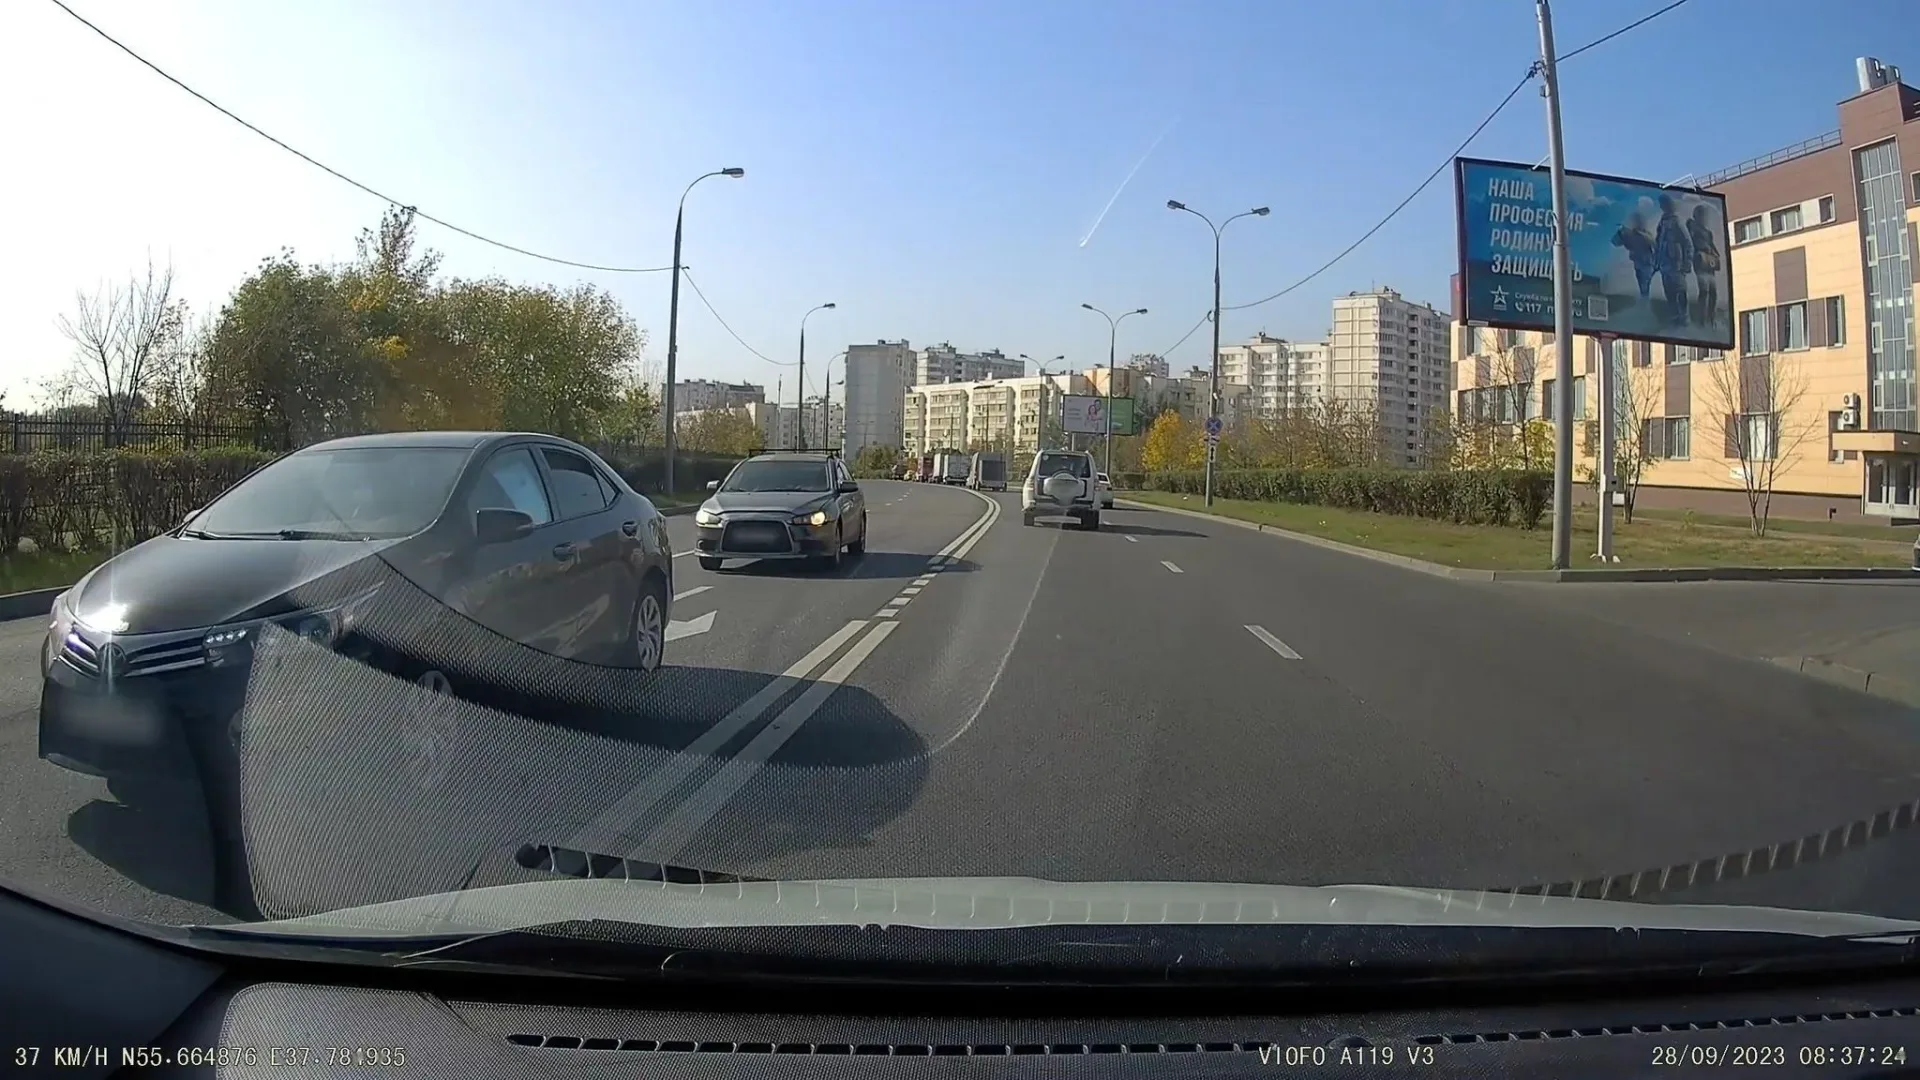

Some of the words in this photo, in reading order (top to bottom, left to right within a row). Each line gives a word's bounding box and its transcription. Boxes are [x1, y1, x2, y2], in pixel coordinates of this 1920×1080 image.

[1488, 177, 1534, 201] НАША
[1489, 202, 1584, 231] ПРОФЕСИЯ
[1490, 227, 1554, 252] РОДИНУ
[1491, 253, 1582, 282] ЗАЩИЩЬ
[1526, 302, 1542, 313] 117
